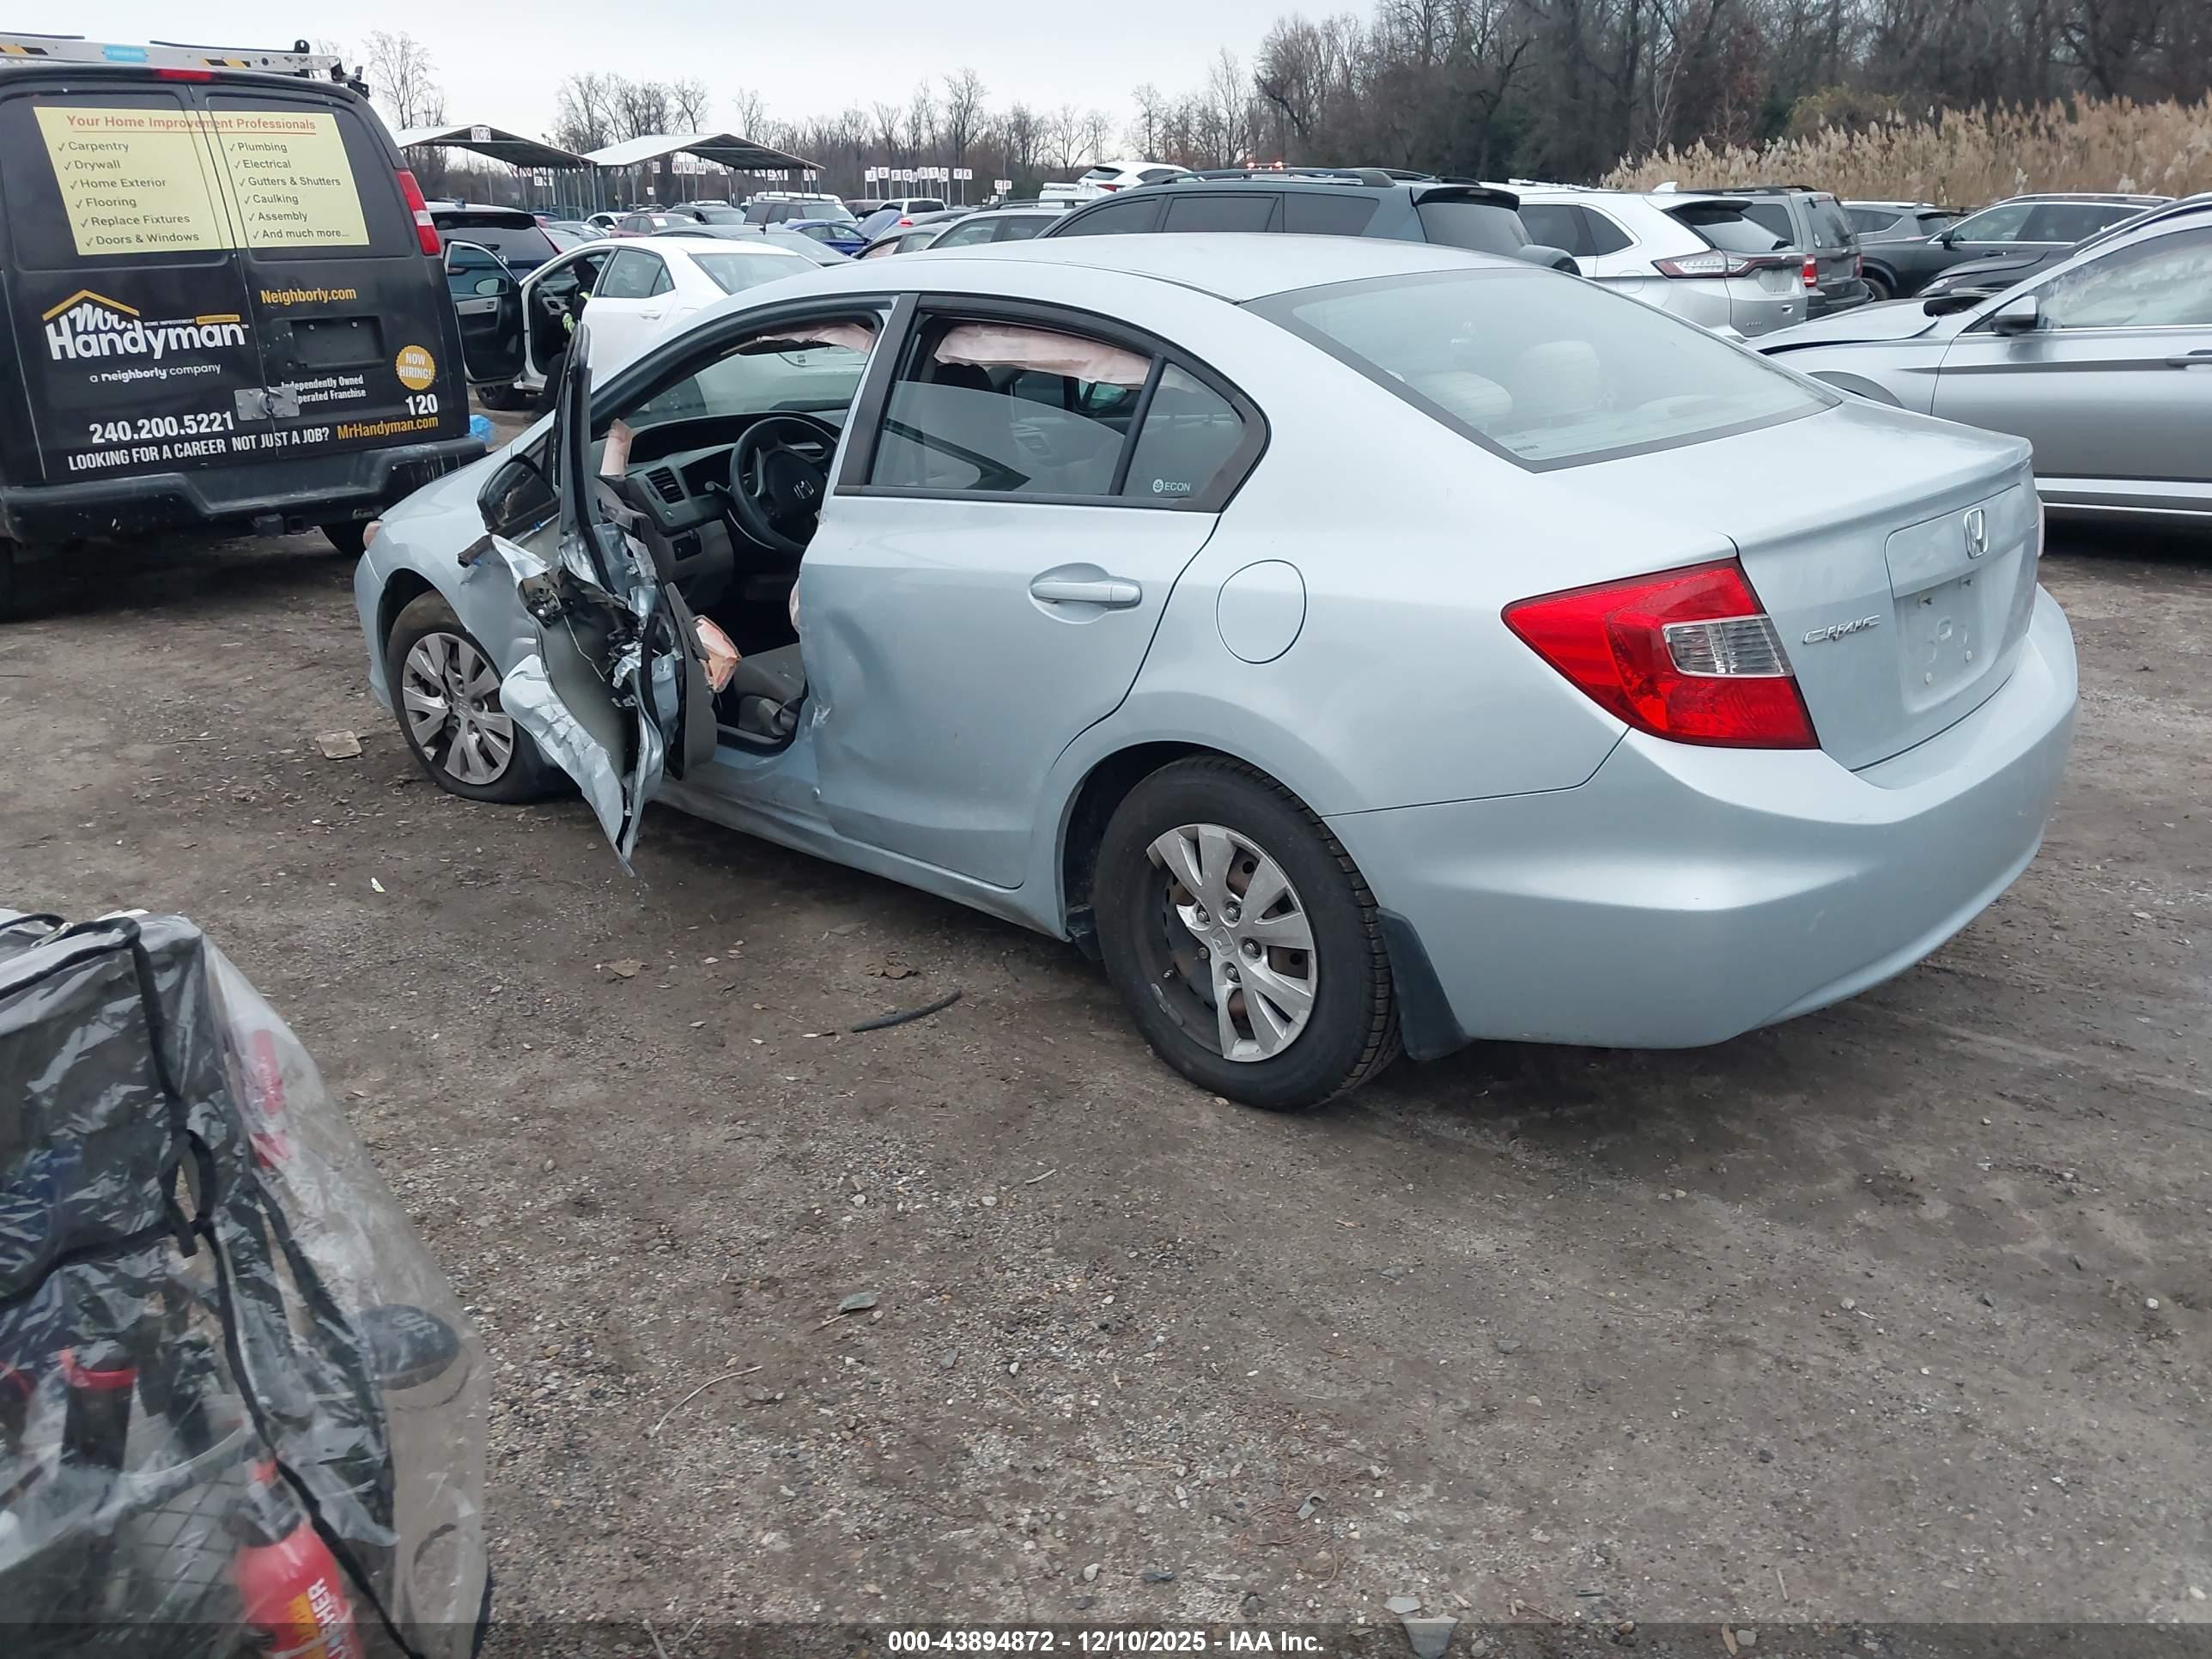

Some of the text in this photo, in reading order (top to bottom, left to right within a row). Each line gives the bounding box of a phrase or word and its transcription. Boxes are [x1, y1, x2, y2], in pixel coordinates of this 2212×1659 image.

[67, 115, 315, 130] Your Home Improvement Professionals
[69, 142, 129, 153] Carpentry
[238, 143, 288, 153] Plumbing
[74, 160, 121, 171] Drywall
[243, 159, 291, 169] Electrical
[80, 178, 167, 189] Home Exterior
[248, 177, 341, 187] Gutters & Shutters
[86, 198, 137, 209] Flooring
[252, 194, 299, 205] Caulking
[91, 214, 191, 228] Replace Fixtures
[258, 212, 308, 222] Assembly
[96, 232, 200, 246] Doors & Windows
[262, 228, 283, 239] And
[286, 228, 314, 239] much
[260, 288, 357, 306] Neighborly.com
[68, 303, 134, 333] Mr.
[45, 314, 246, 360] Handyman
[404, 351, 426, 366] NOW
[89, 363, 222, 384] a neighborly company
[398, 366, 432, 380] HIRING!
[338, 374, 364, 387] Owned
[297, 387, 367, 405] perated Franchise
[404, 392, 439, 416] 120
[88, 410, 234, 444] 240.200.5221
[68, 416, 439, 471] LOOKING FOR A CAREER NOT JUST A JOB? MrHandyman.com
[1164, 482, 1191, 492] ECON
